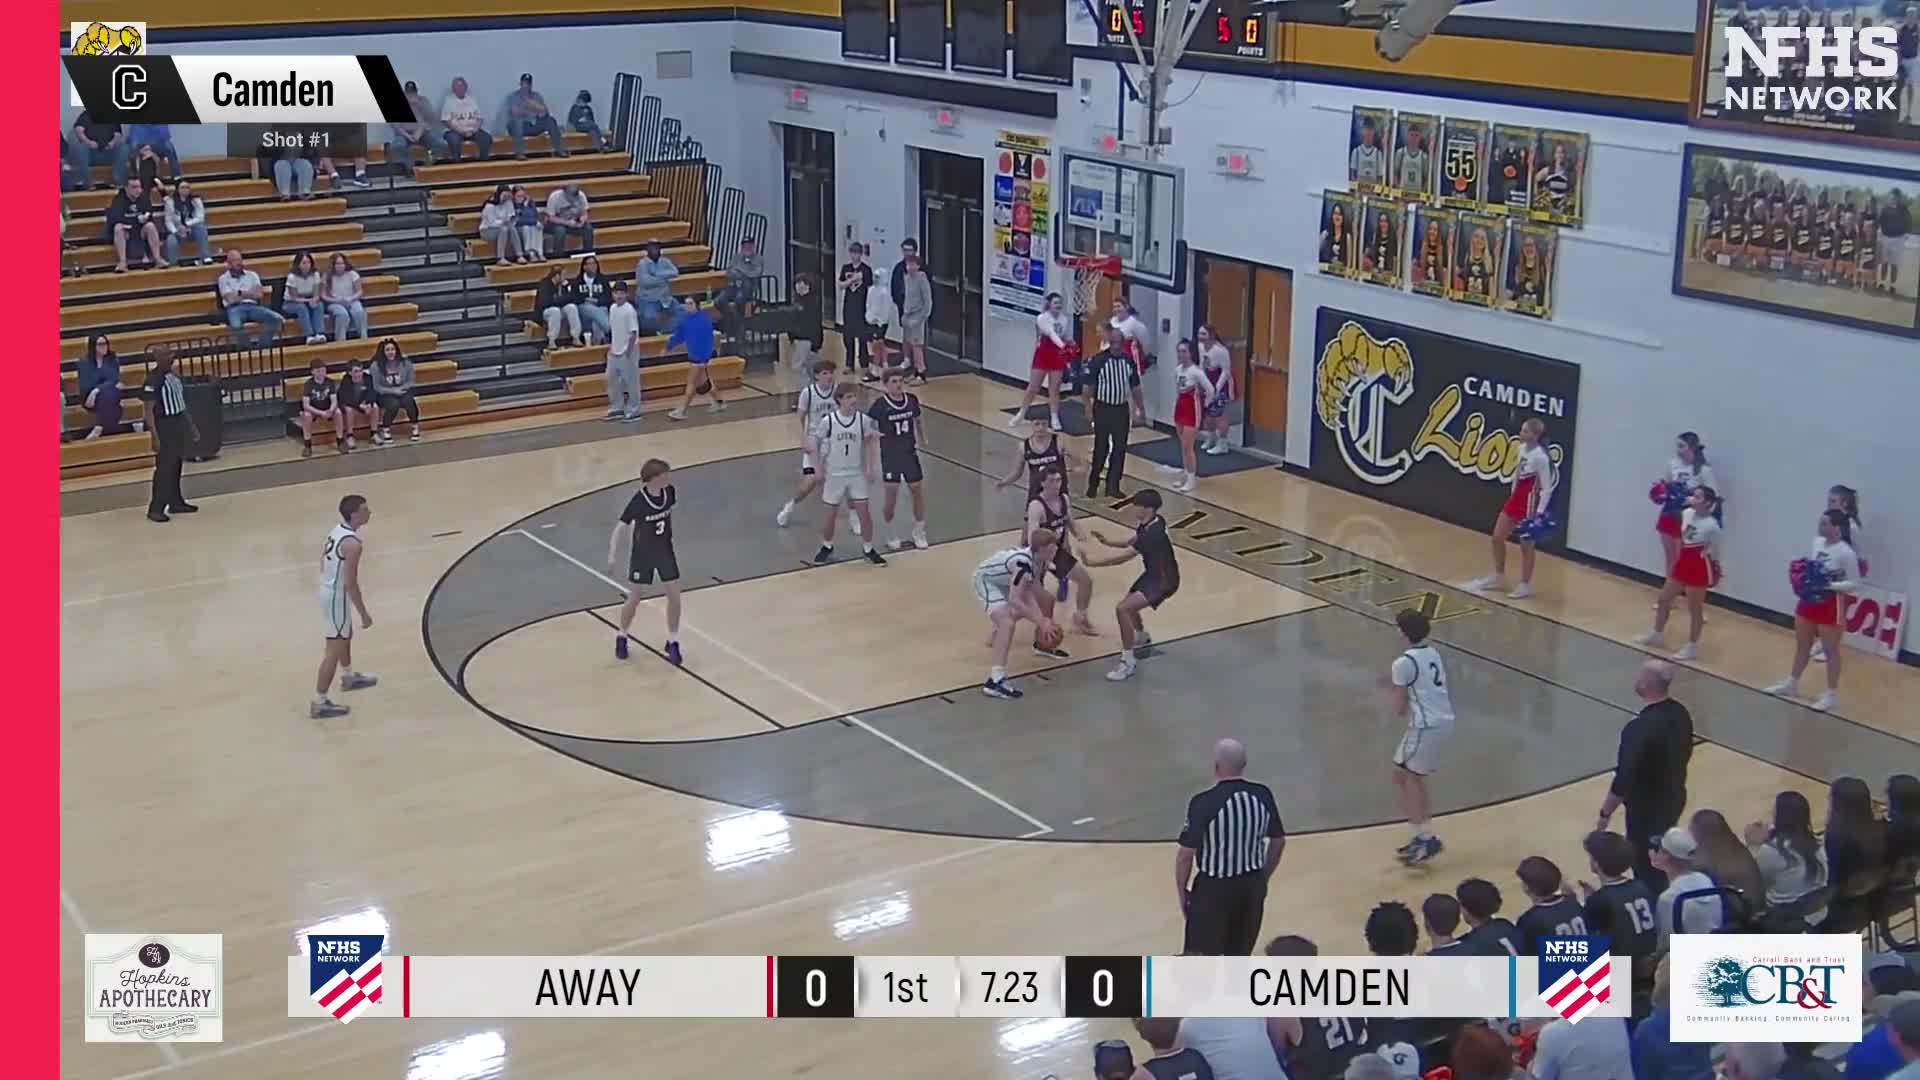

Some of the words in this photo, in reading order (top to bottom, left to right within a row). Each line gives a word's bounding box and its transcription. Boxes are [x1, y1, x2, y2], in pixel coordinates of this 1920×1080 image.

[1246, 19, 1258, 43] 0
[1447, 148, 1475, 178] 55
[1463, 376, 1564, 417] CAMDEN
[894, 420, 909, 435] 14
[844, 444, 849, 456] 1
[655, 521, 665, 535] 3
[1430, 662, 1442, 686] 2
[1625, 897, 1654, 934] 13
